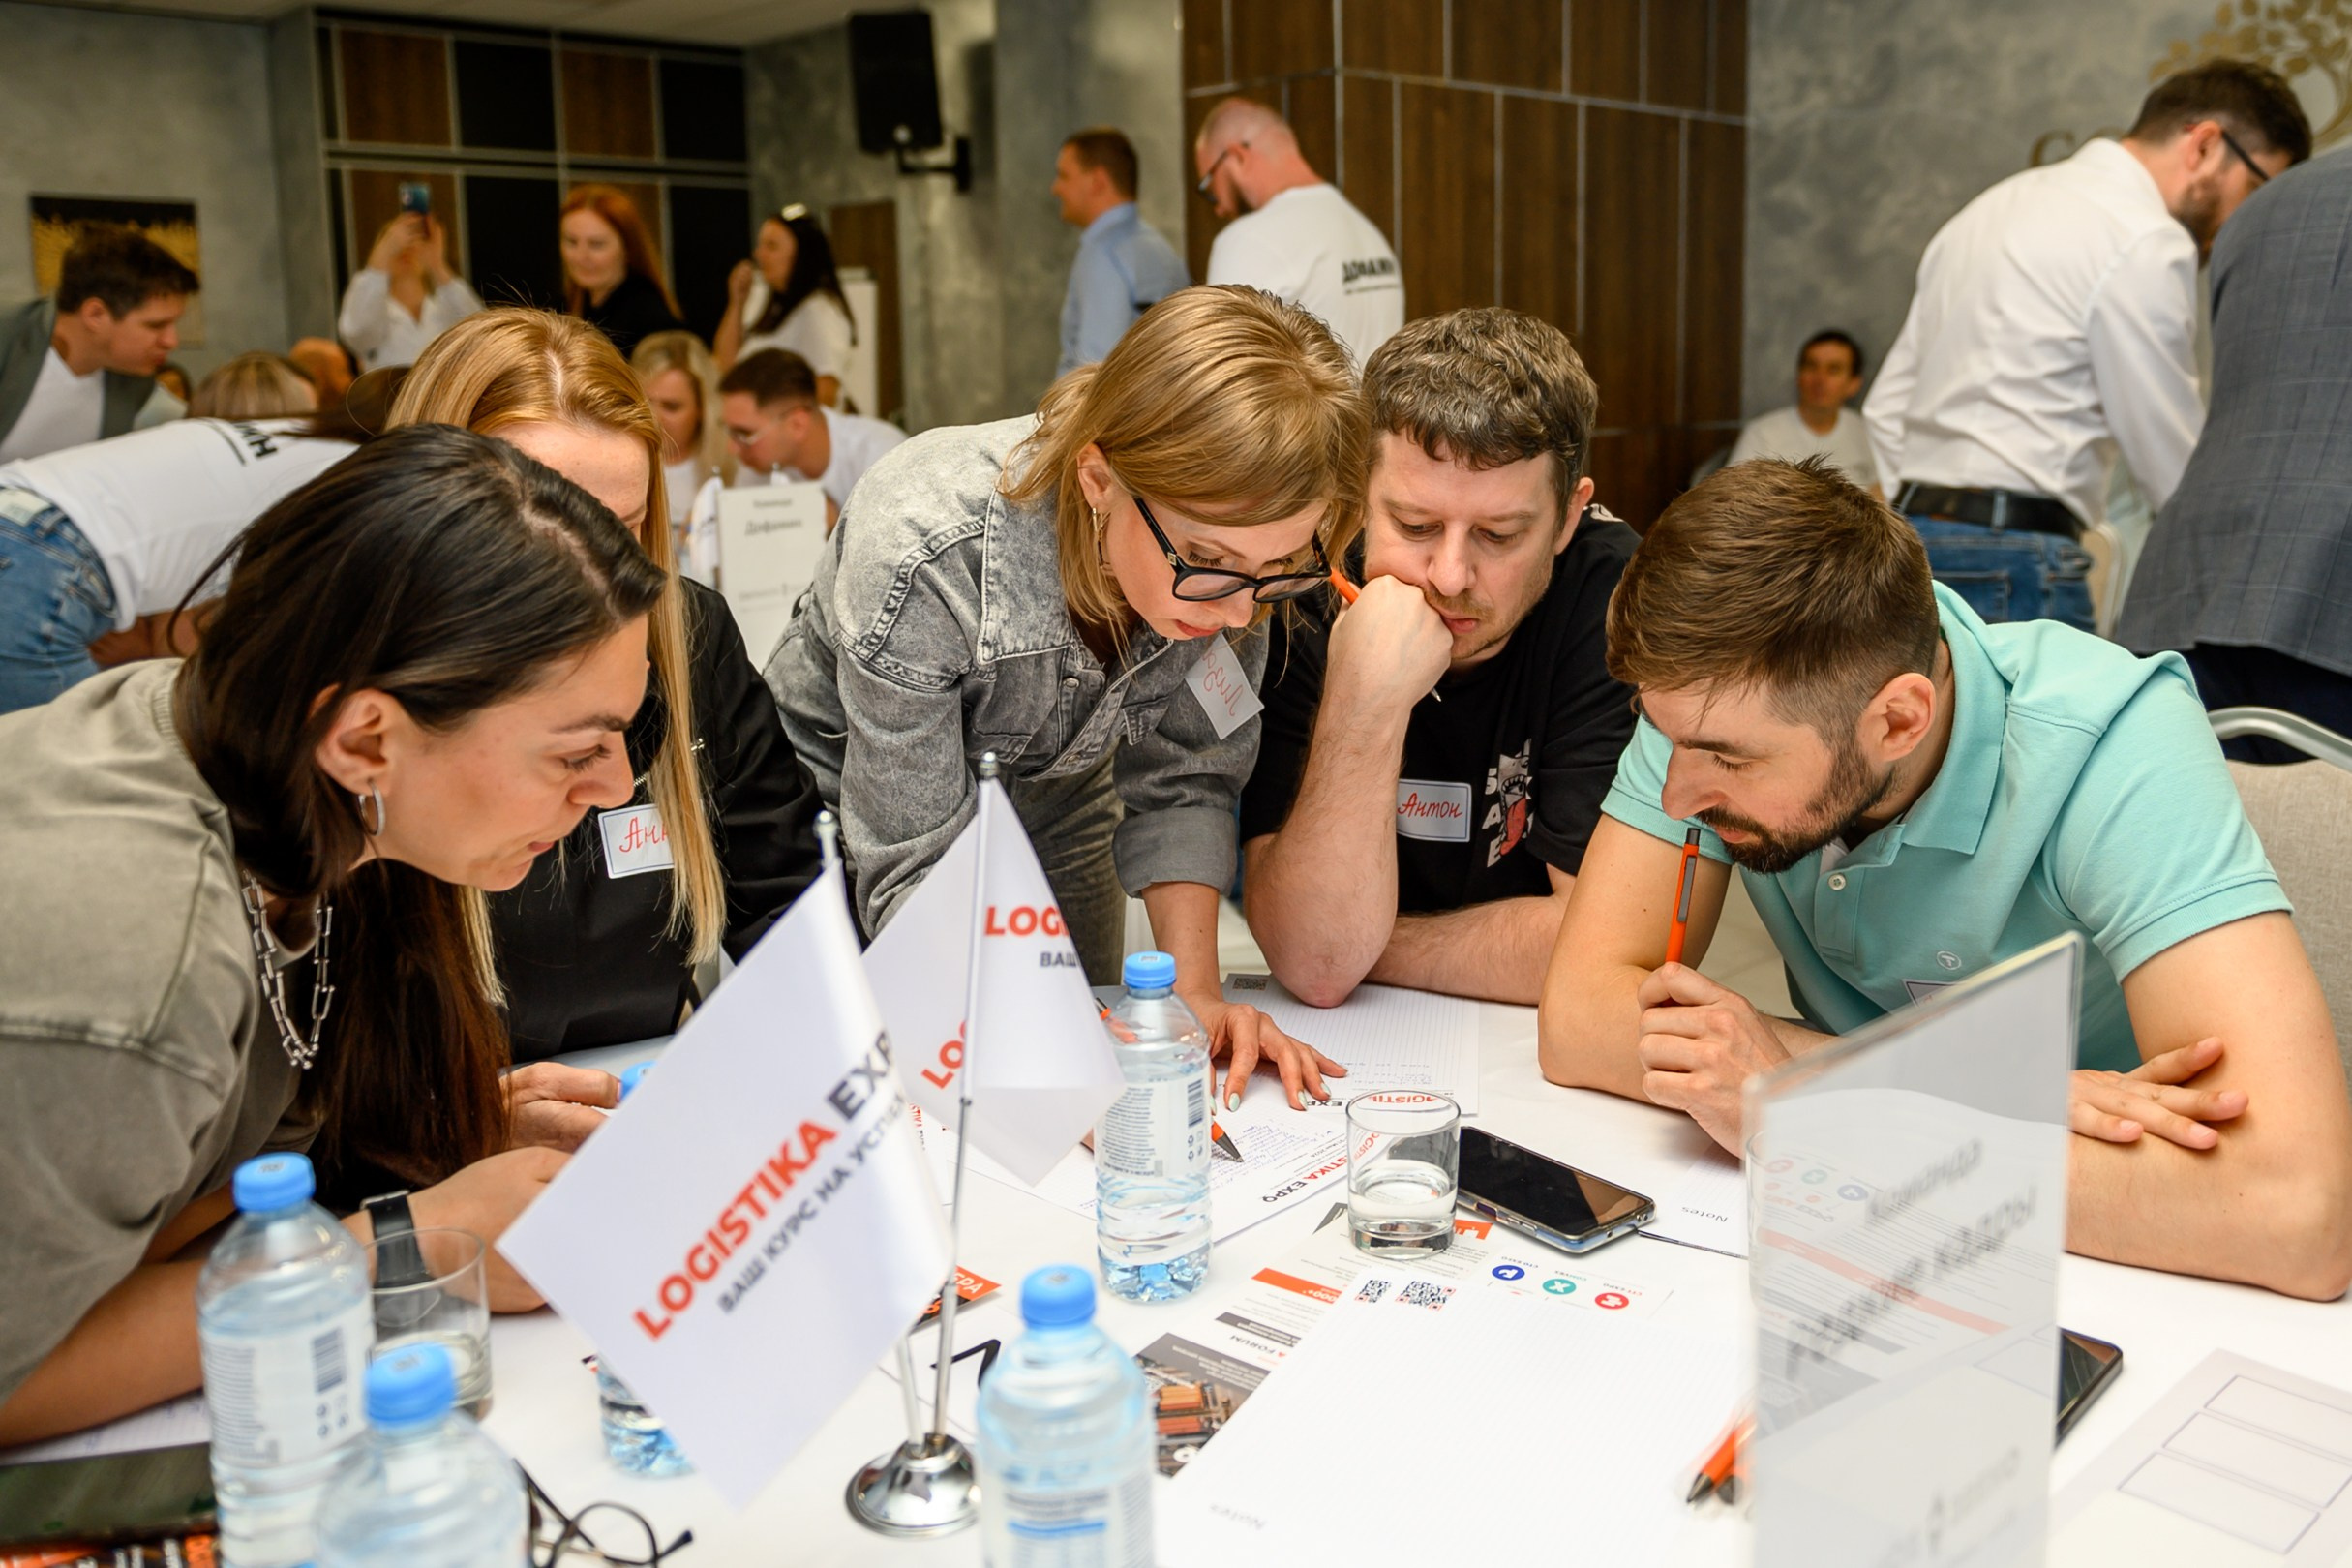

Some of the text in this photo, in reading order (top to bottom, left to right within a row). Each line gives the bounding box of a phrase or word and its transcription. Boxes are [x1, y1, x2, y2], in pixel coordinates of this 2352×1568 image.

[1397, 792, 1463, 819] Антон
[983, 905, 1070, 938] LOG
[920, 1019, 966, 1091] LO
[1302, 1154, 1348, 1181] STIKA
[632, 1029, 894, 1342] LOGISTIKA EXP
[1681, 1206, 1729, 1223] Notes
[717, 1255, 767, 1315] ВАШ
[762, 1197, 819, 1262] КУРС
[813, 1164, 853, 1205] НА
[1229, 1334, 1277, 1356] FORUM
